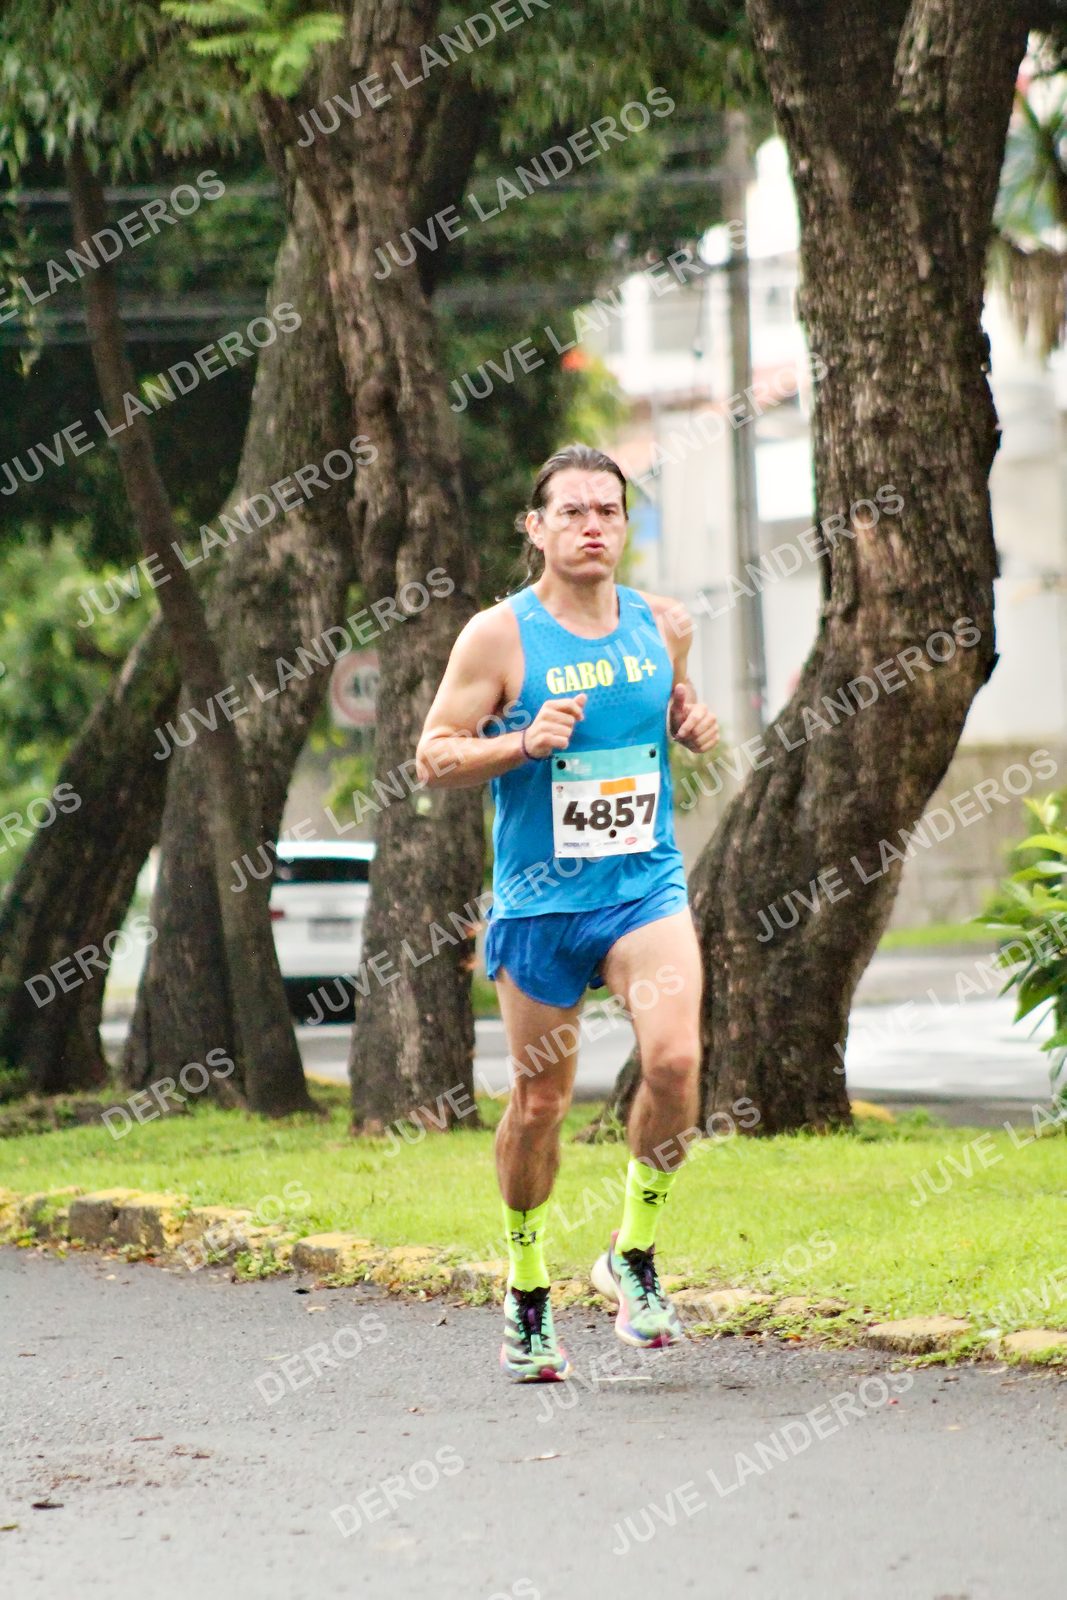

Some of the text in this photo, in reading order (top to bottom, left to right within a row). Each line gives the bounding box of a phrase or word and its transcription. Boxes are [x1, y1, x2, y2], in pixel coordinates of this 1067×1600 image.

[546, 656, 657, 694] GABO B+
[563, 793, 656, 831] 4857
